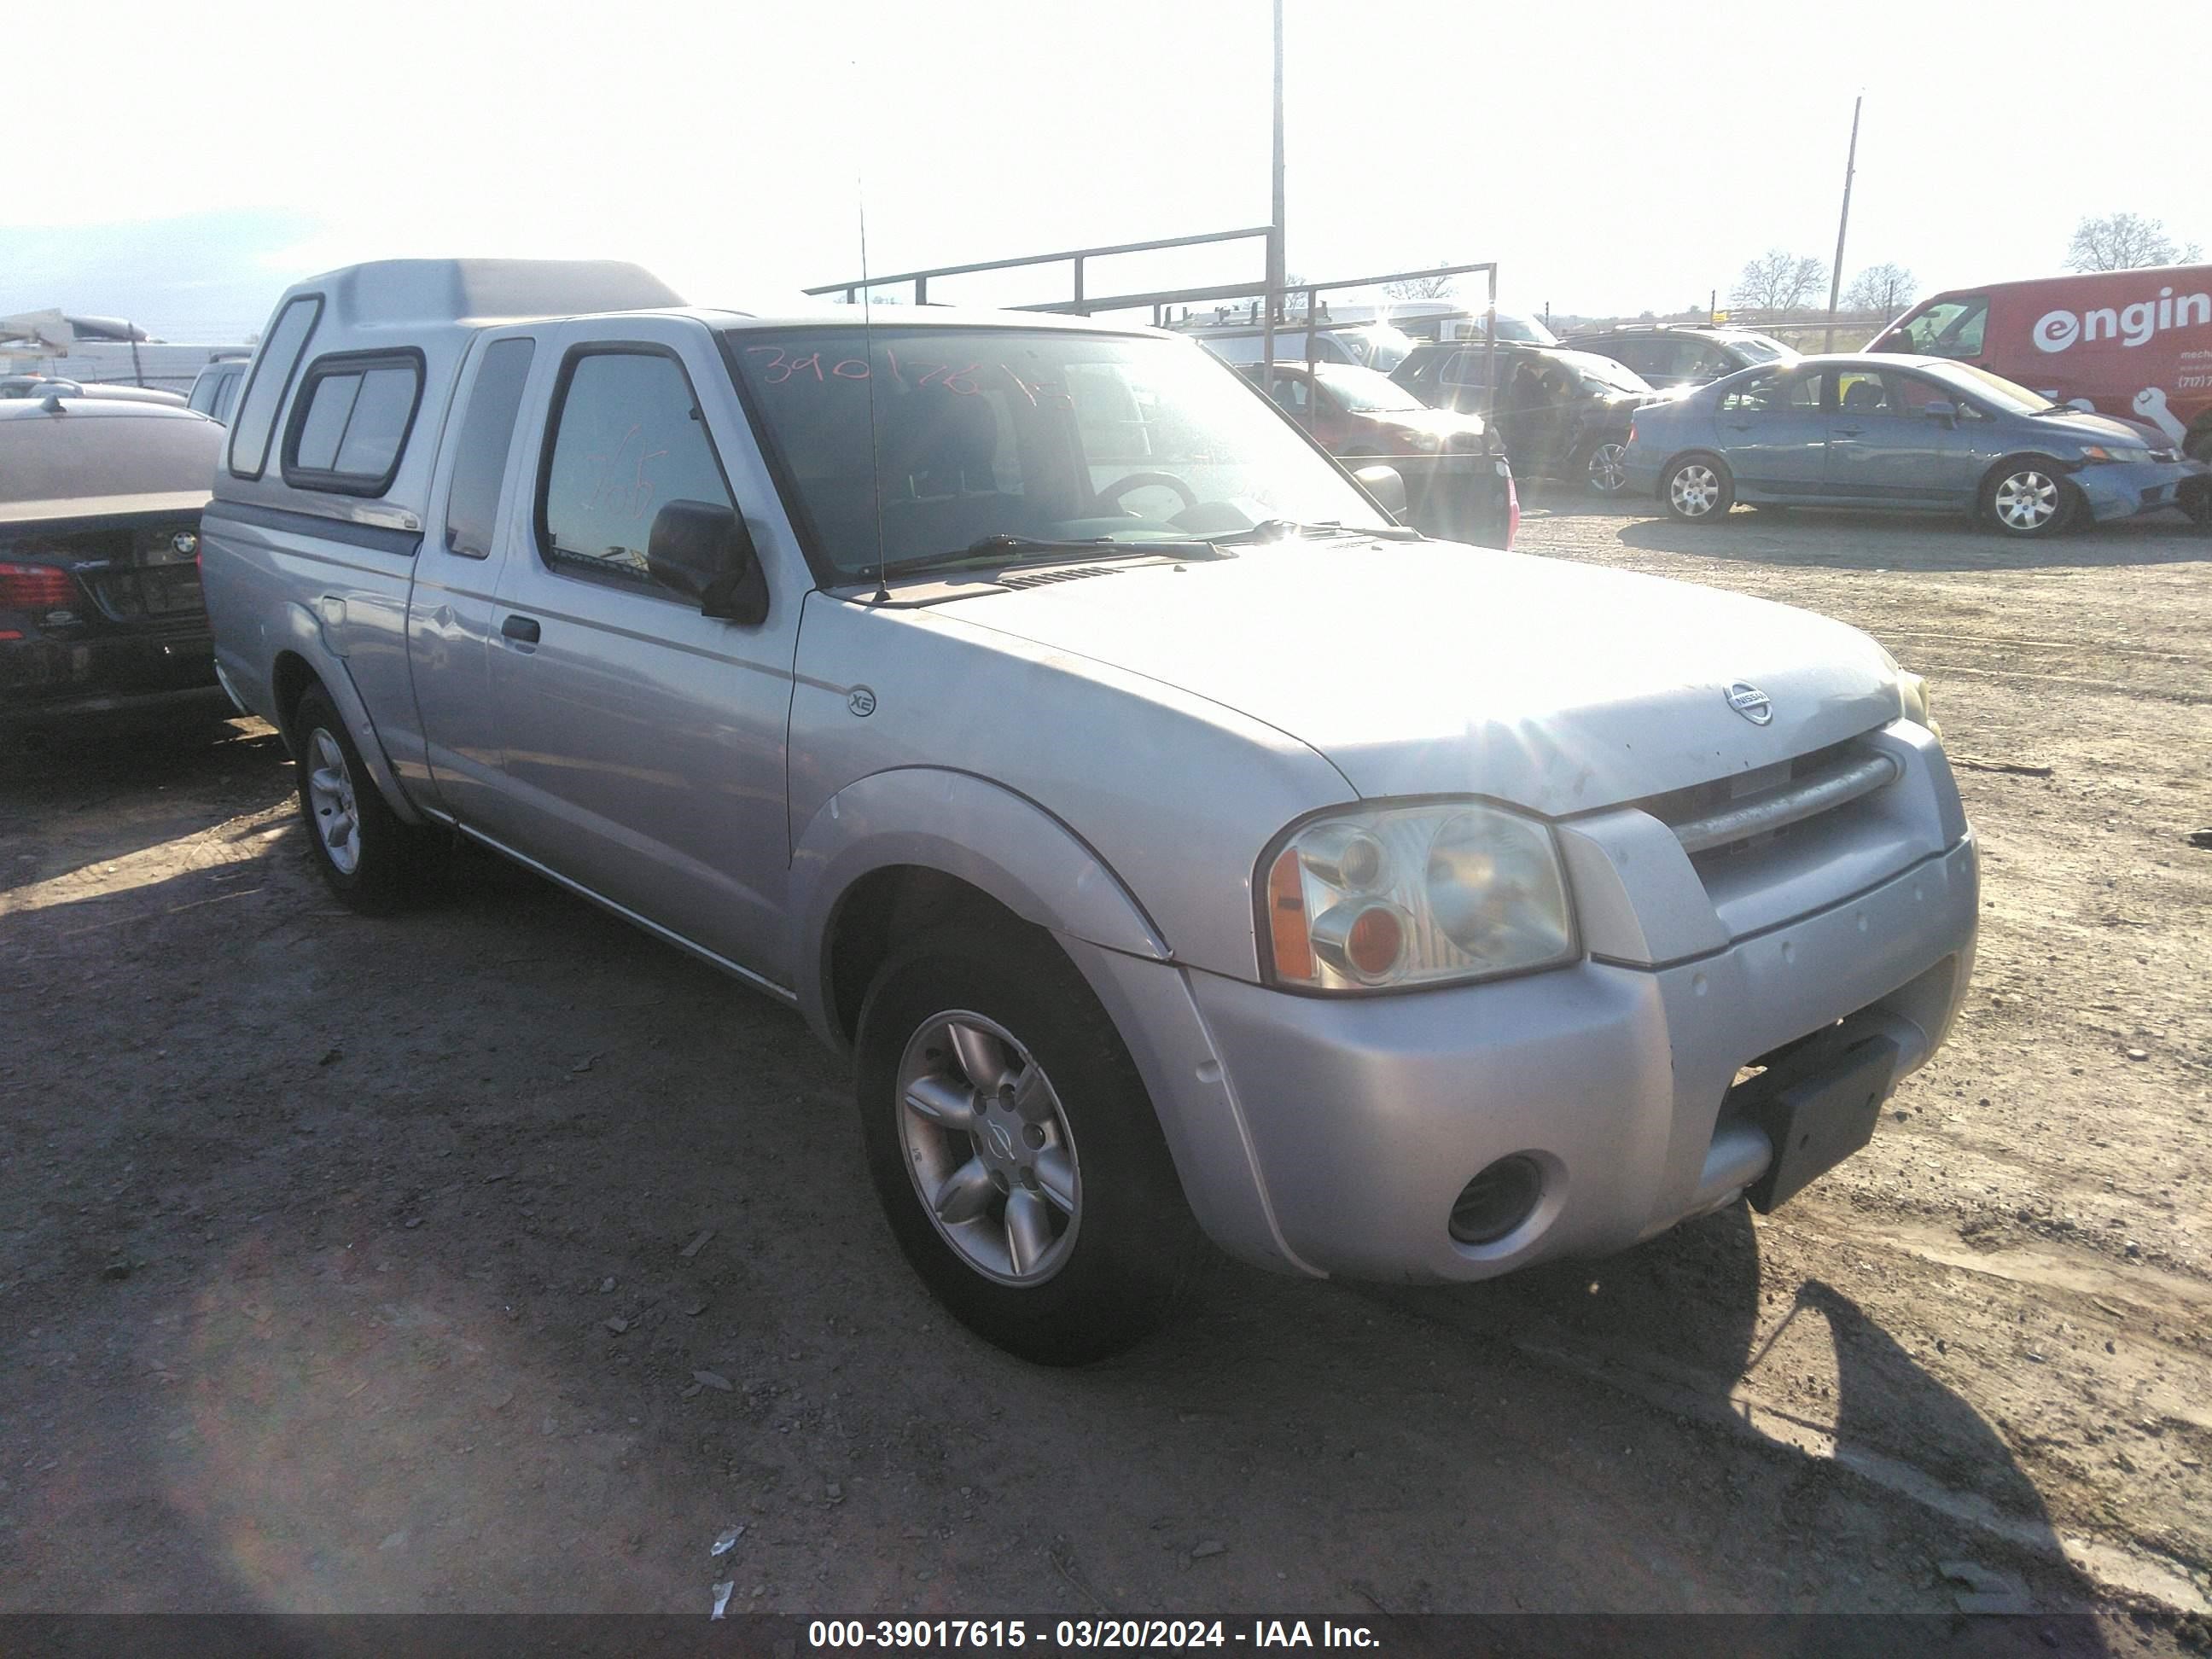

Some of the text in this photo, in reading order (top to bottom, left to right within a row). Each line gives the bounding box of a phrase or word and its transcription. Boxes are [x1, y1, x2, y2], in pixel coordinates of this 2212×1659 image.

[2033, 287, 2211, 352] engin
[2178, 375, 2205, 387] (717)
[851, 694, 873, 712] XE
